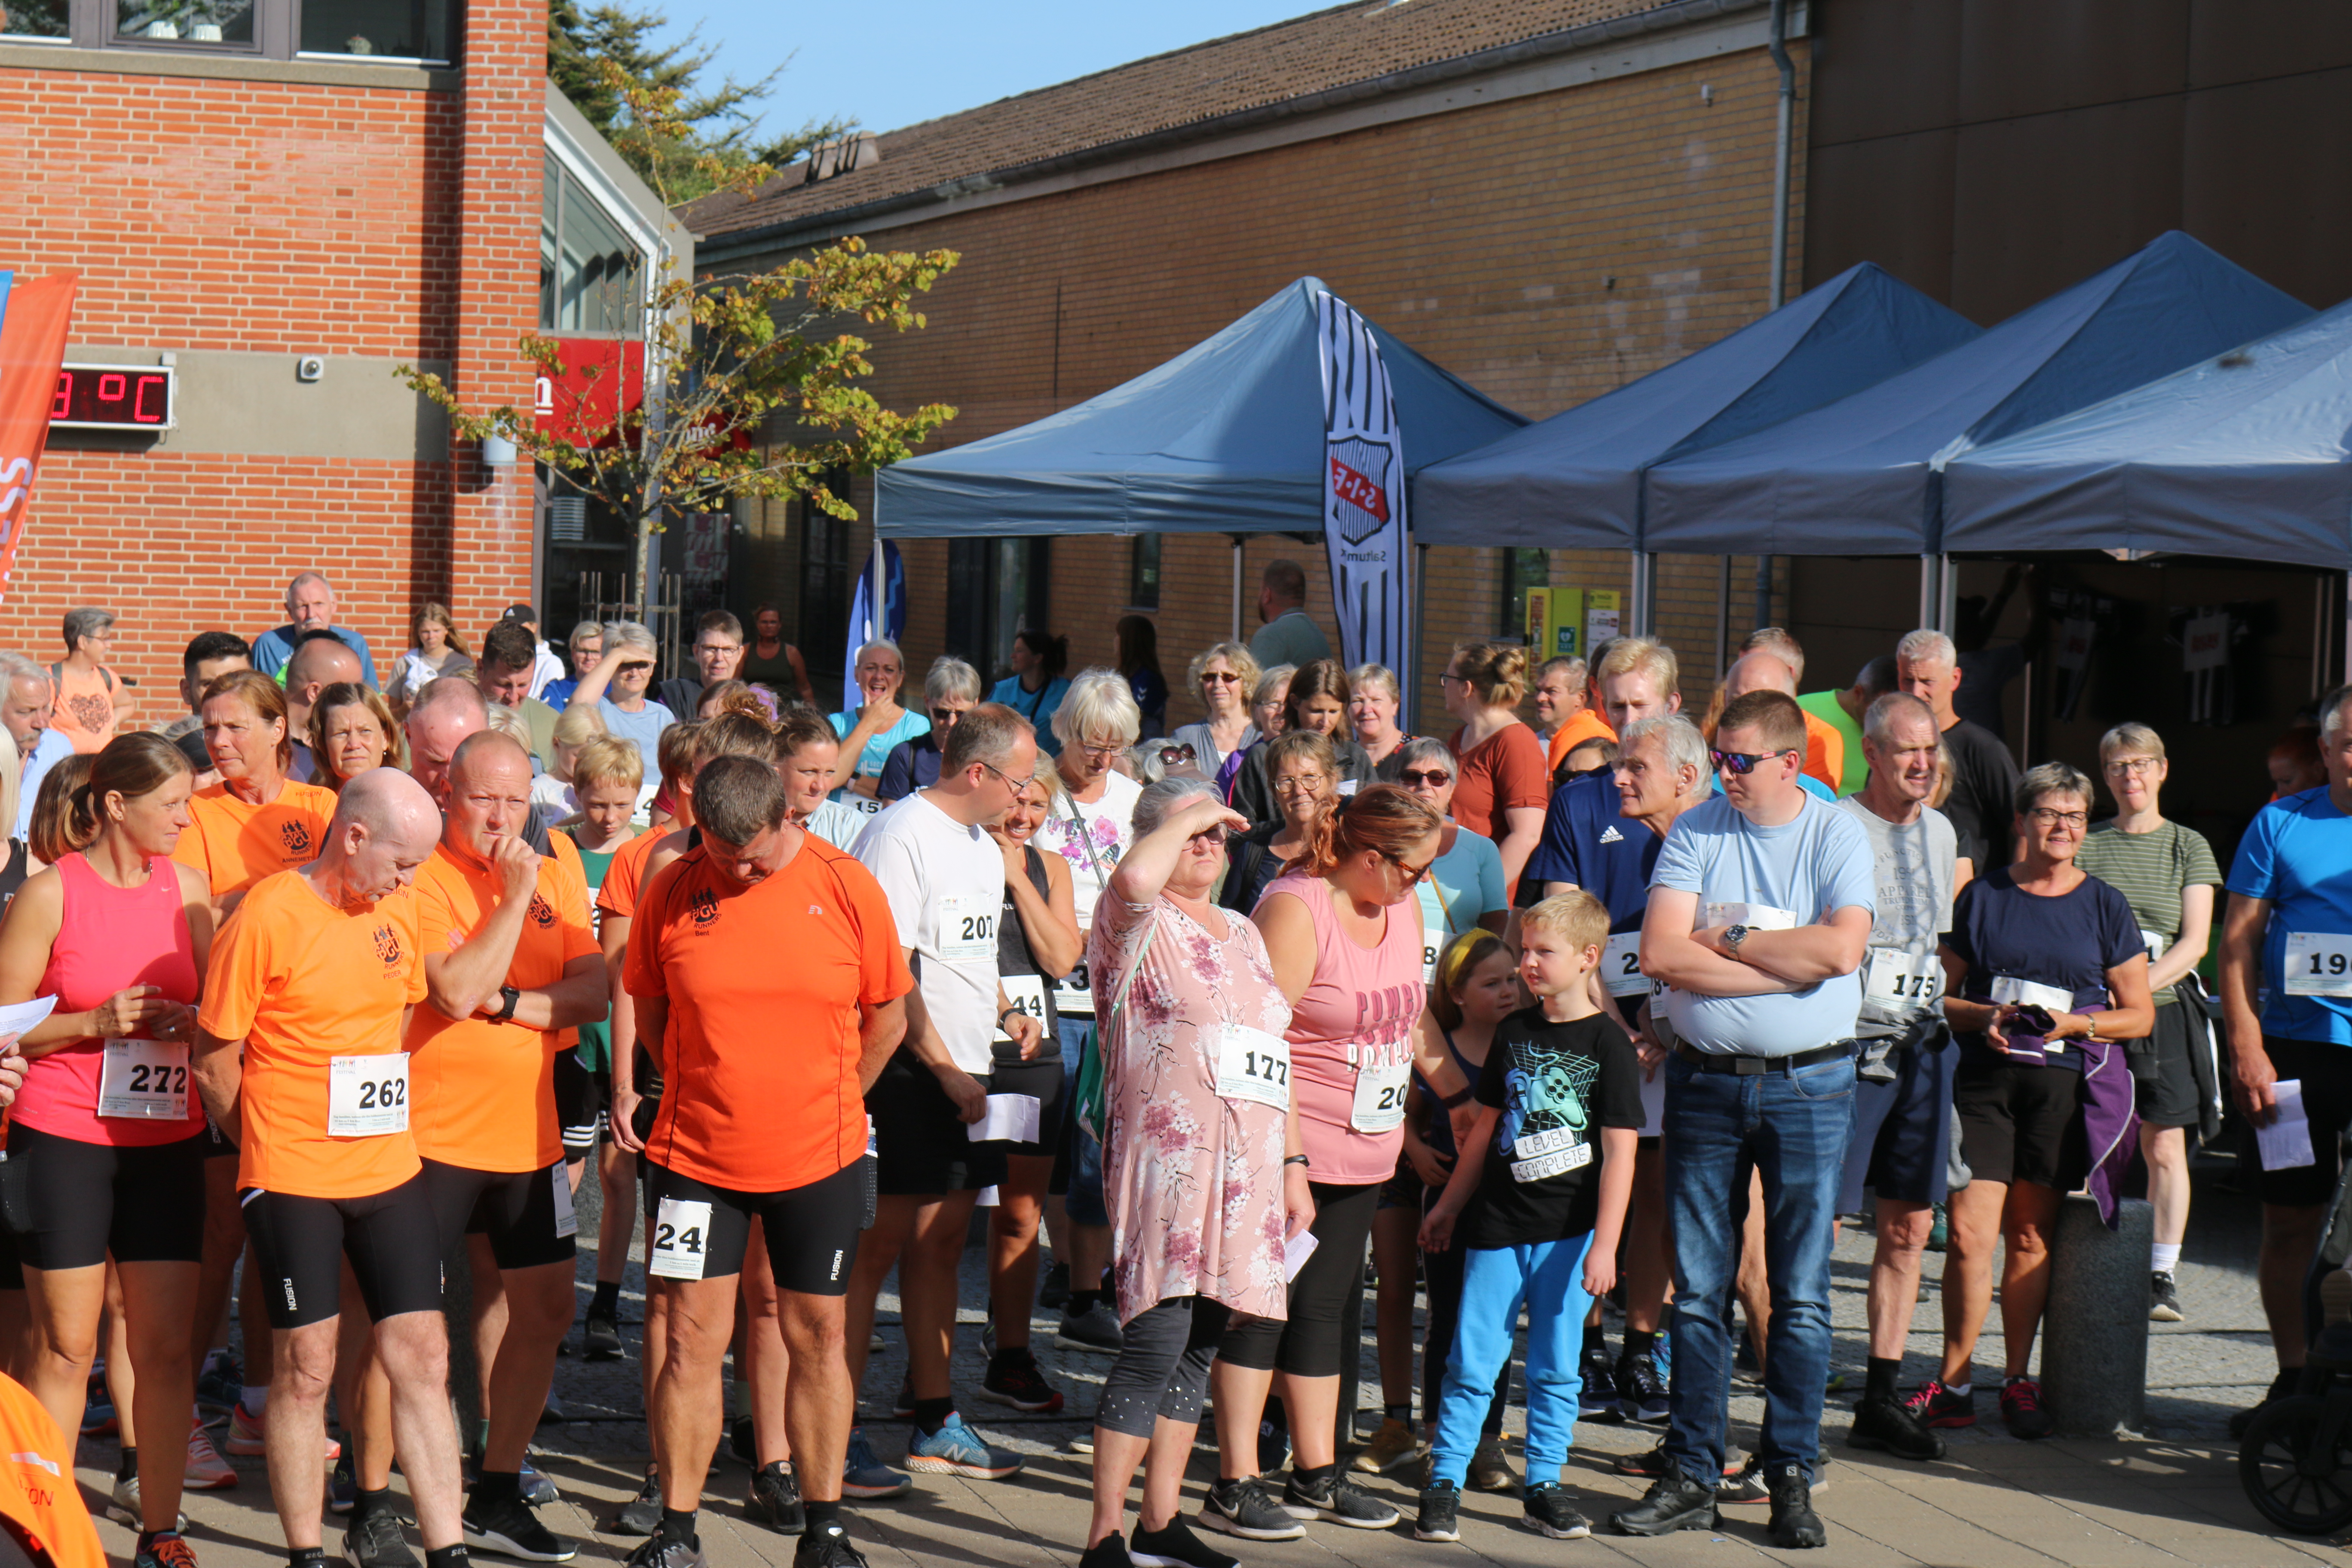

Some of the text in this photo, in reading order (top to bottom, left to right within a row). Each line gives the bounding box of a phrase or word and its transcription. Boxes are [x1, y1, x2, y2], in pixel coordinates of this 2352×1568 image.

[1600, 834, 1624, 843] adidas
[539, 916, 558, 930] RUNNERS
[693, 913, 722, 929] RUNNERS
[962, 915, 993, 940] 207
[384, 951, 405, 970] RUNNERS
[1621, 952, 1640, 975] 2
[2309, 952, 2352, 975] 19
[383, 970, 401, 980] PEDER
[1893, 974, 1935, 998] 175
[129, 1064, 187, 1094] 272
[1245, 1050, 1287, 1087] 177
[359, 1077, 405, 1109] 262
[1377, 1082, 1406, 1110] 20
[1524, 1130, 1569, 1155] LEVEL
[1517, 1147, 1587, 1179] COMPLETE
[654, 1223, 702, 1253] 24
[830, 1250, 844, 1280] FUSION
[283, 1278, 297, 1311] FUSION
